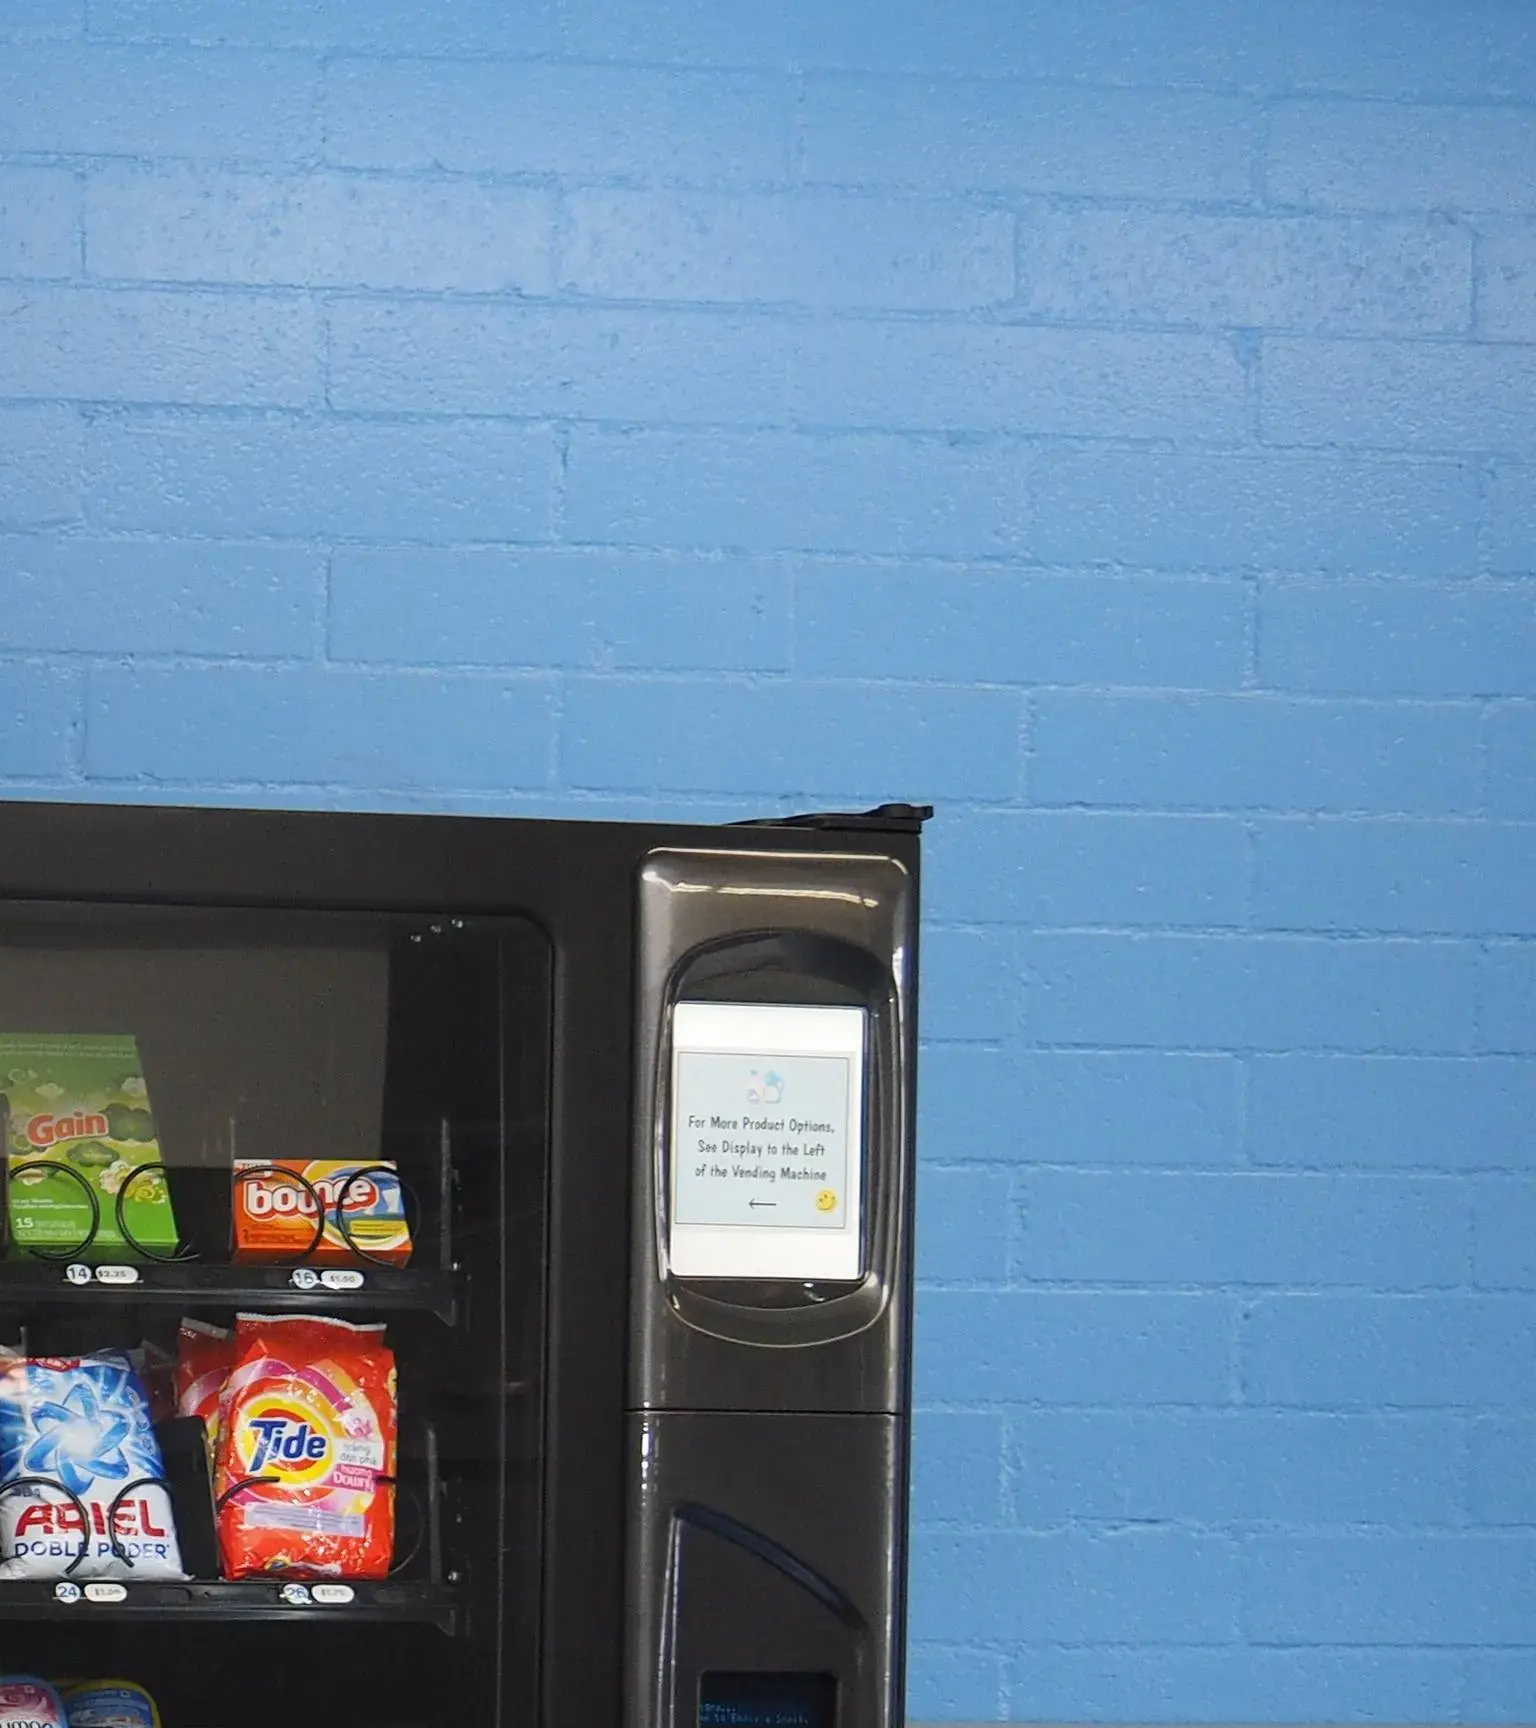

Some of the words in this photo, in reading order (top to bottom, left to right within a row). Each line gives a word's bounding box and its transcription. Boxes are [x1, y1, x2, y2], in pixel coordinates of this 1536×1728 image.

[28, 1111, 107, 1146] Gain
[688, 1115, 705, 1129] For
[710, 1116, 737, 1130] More
[742, 1117, 784, 1132] Product
[789, 1118, 835, 1135] Options,
[697, 1140, 717, 1153] See
[722, 1140, 762, 1158] Display
[767, 1142, 777, 1155] to
[781, 1143, 799, 1156] the
[803, 1143, 825, 1157] Left
[694, 1163, 706, 1178] of
[710, 1164, 728, 1178] the
[731, 1165, 776, 1182] Vending
[780, 1167, 827, 1181] Machine
[245, 1177, 377, 1217] bounce
[248, 1419, 327, 1474] Tide
[15, 1499, 165, 1537] ARIEL
[15, 1541, 89, 1558] DOBLE
[59, 1584, 77, 1598] 24
